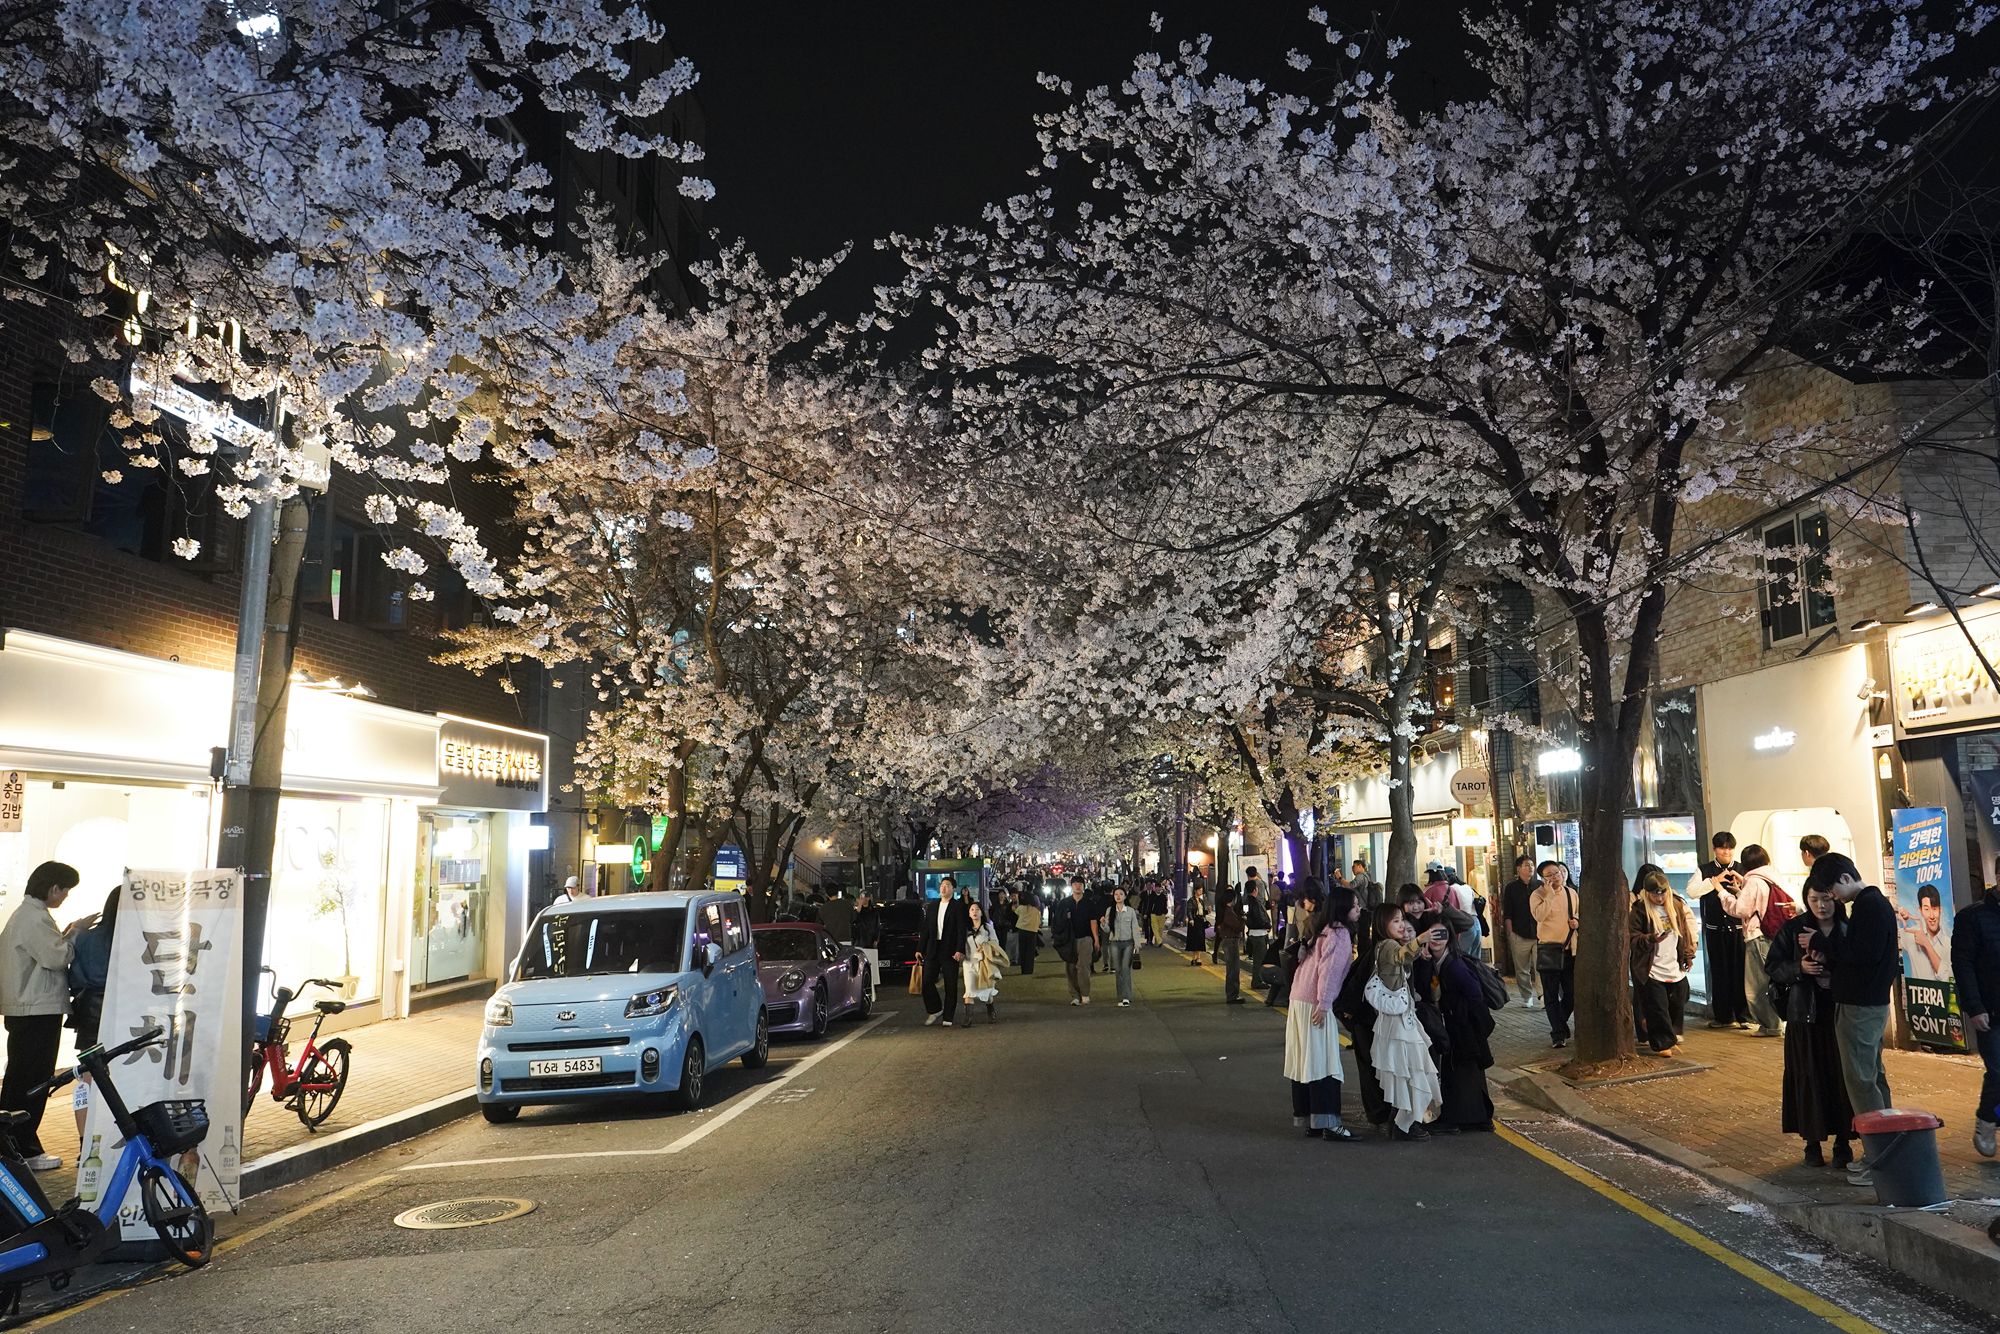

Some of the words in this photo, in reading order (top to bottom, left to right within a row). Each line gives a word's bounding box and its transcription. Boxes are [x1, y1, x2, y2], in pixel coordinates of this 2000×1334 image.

[3, 783, 23, 799] 충무
[1456, 782, 1486, 791] TAROT
[2, 803, 22, 819] 김밥
[1909, 826, 1943, 849] 강력한
[1898, 846, 1943, 869] 리얼탄산
[1916, 863, 1943, 884] 100%
[130, 878, 234, 901] 당인리극장
[1909, 986, 1945, 1008] TERRA
[559, 1011, 575, 1021] KIA
[536, 1061, 559, 1074] 16라
[564, 1059, 595, 1073] 5483
